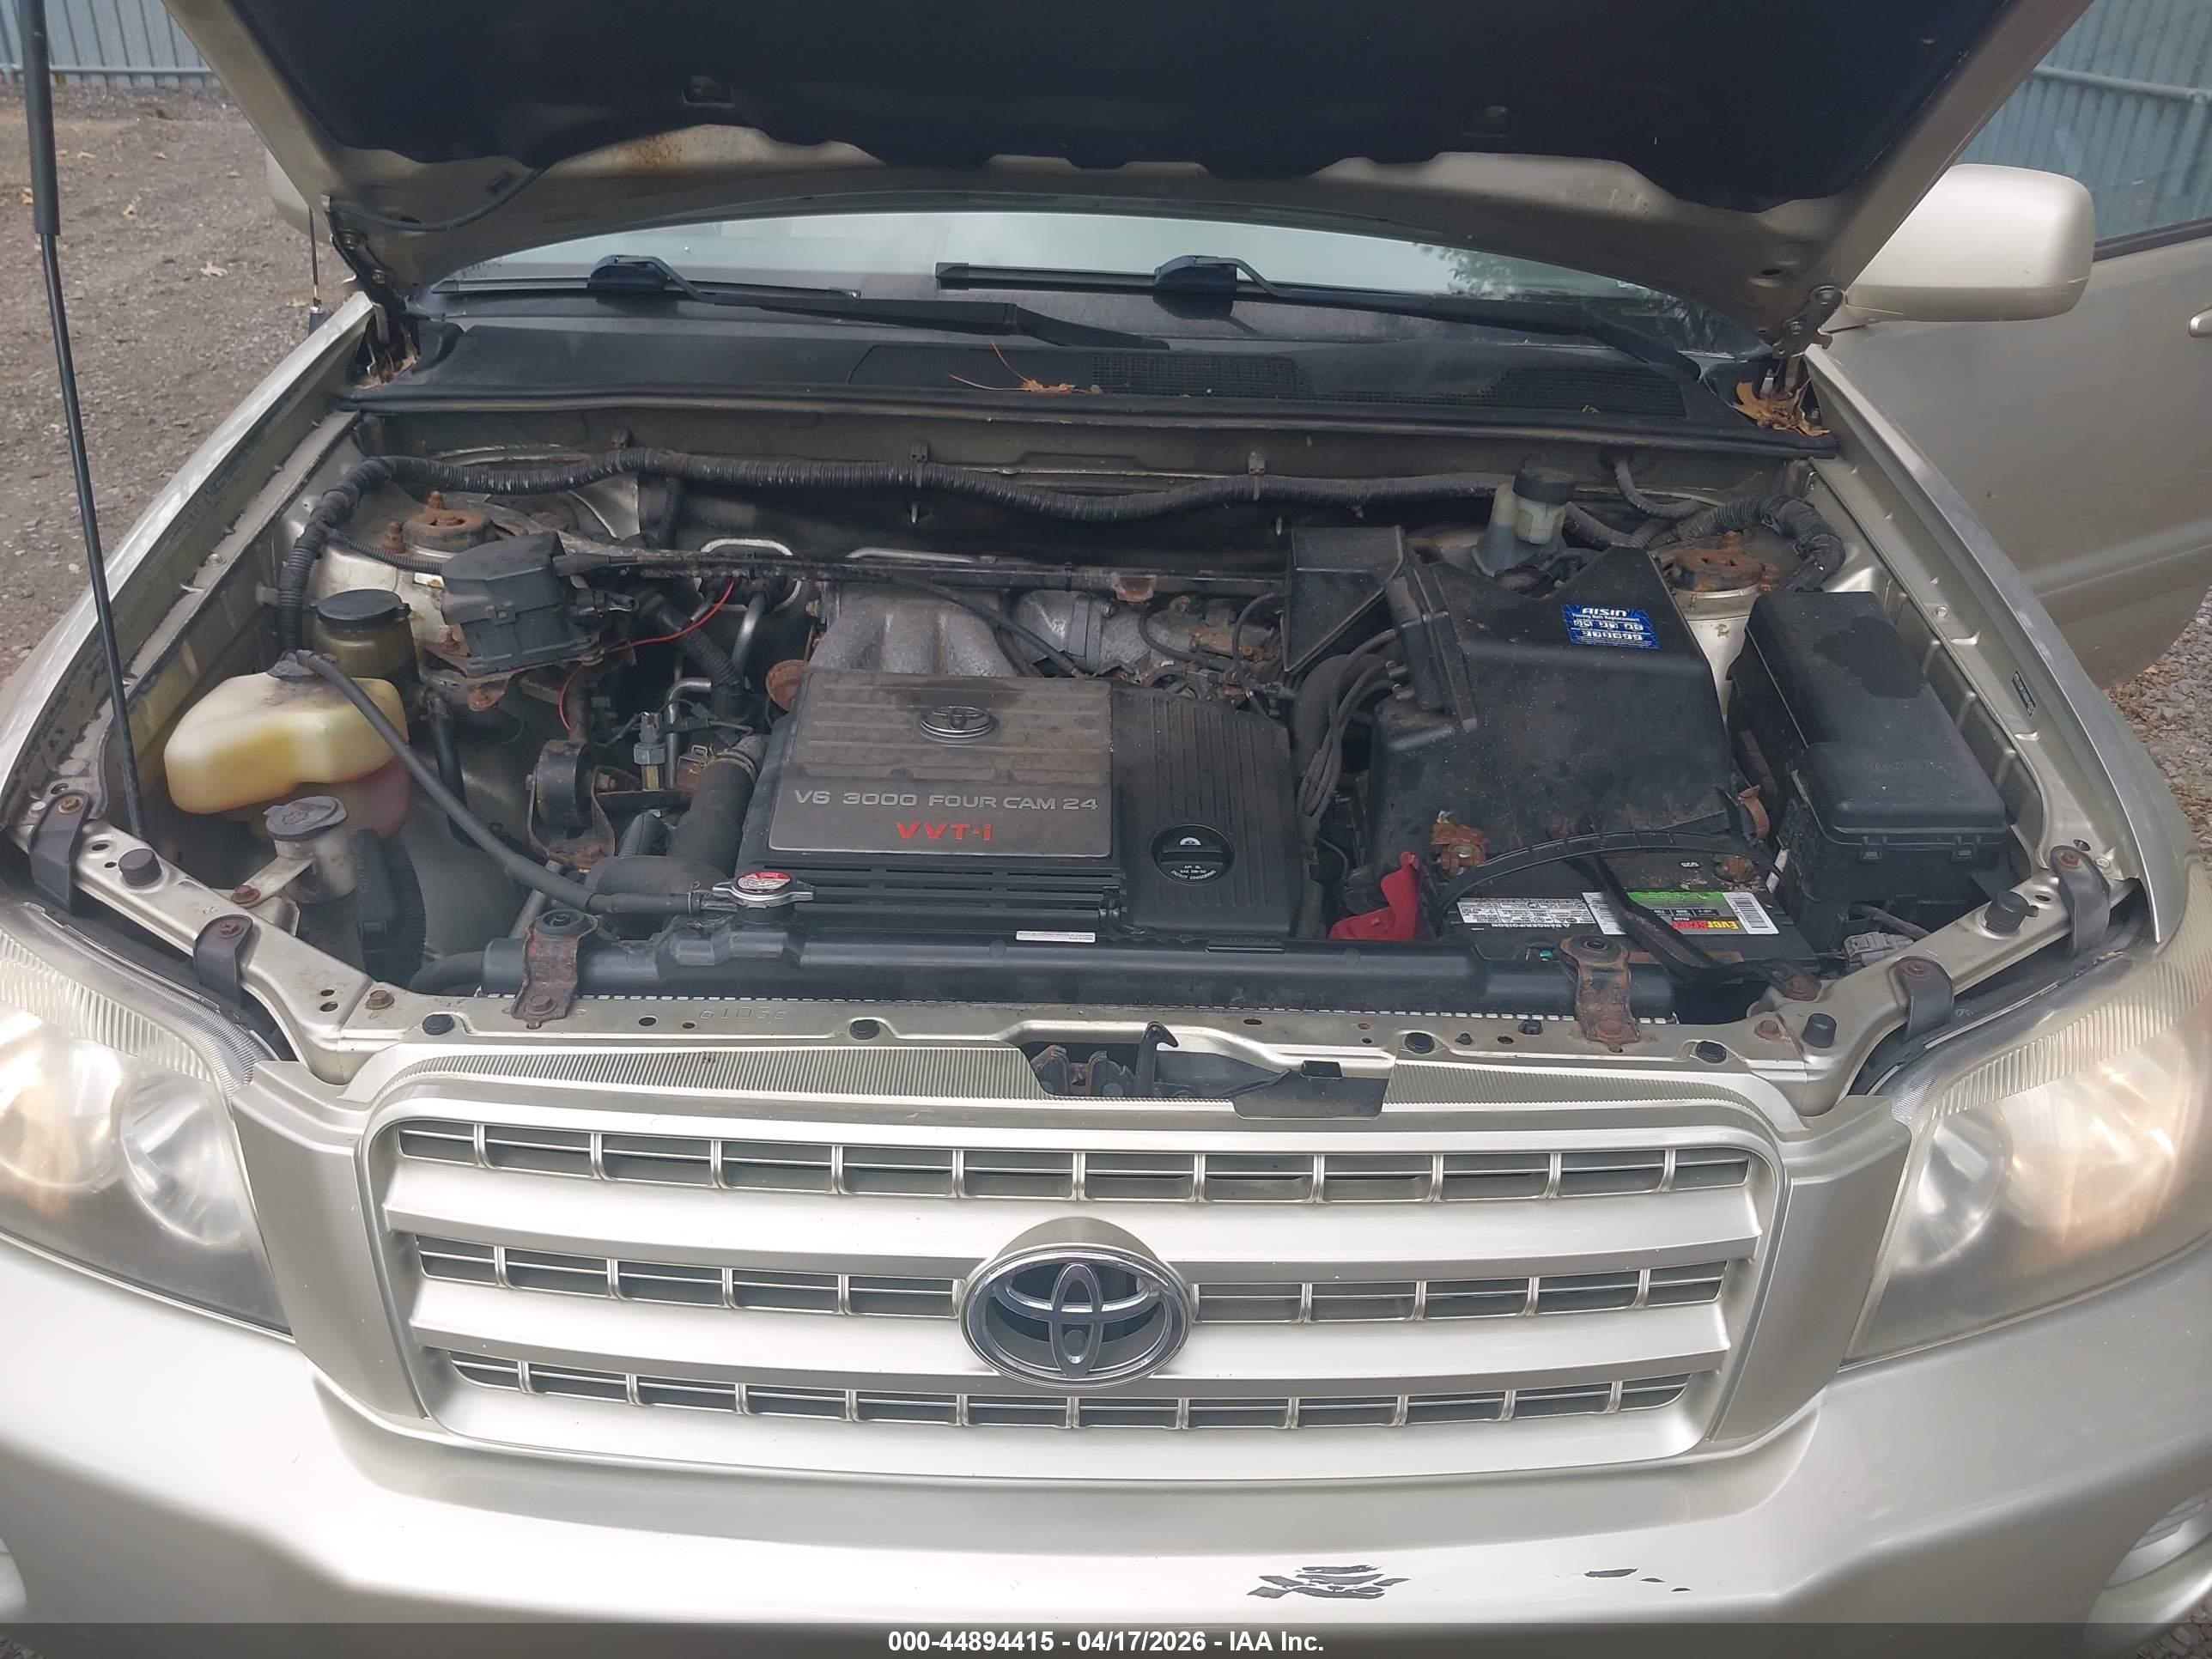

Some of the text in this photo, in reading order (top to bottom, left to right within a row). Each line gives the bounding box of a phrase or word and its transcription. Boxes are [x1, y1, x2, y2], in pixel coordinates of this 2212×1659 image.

[1582, 608, 1627, 617] AISIN
[795, 790, 1099, 811] V6 3000 FOUR CAM 24
[896, 822, 993, 841] VVT-i
